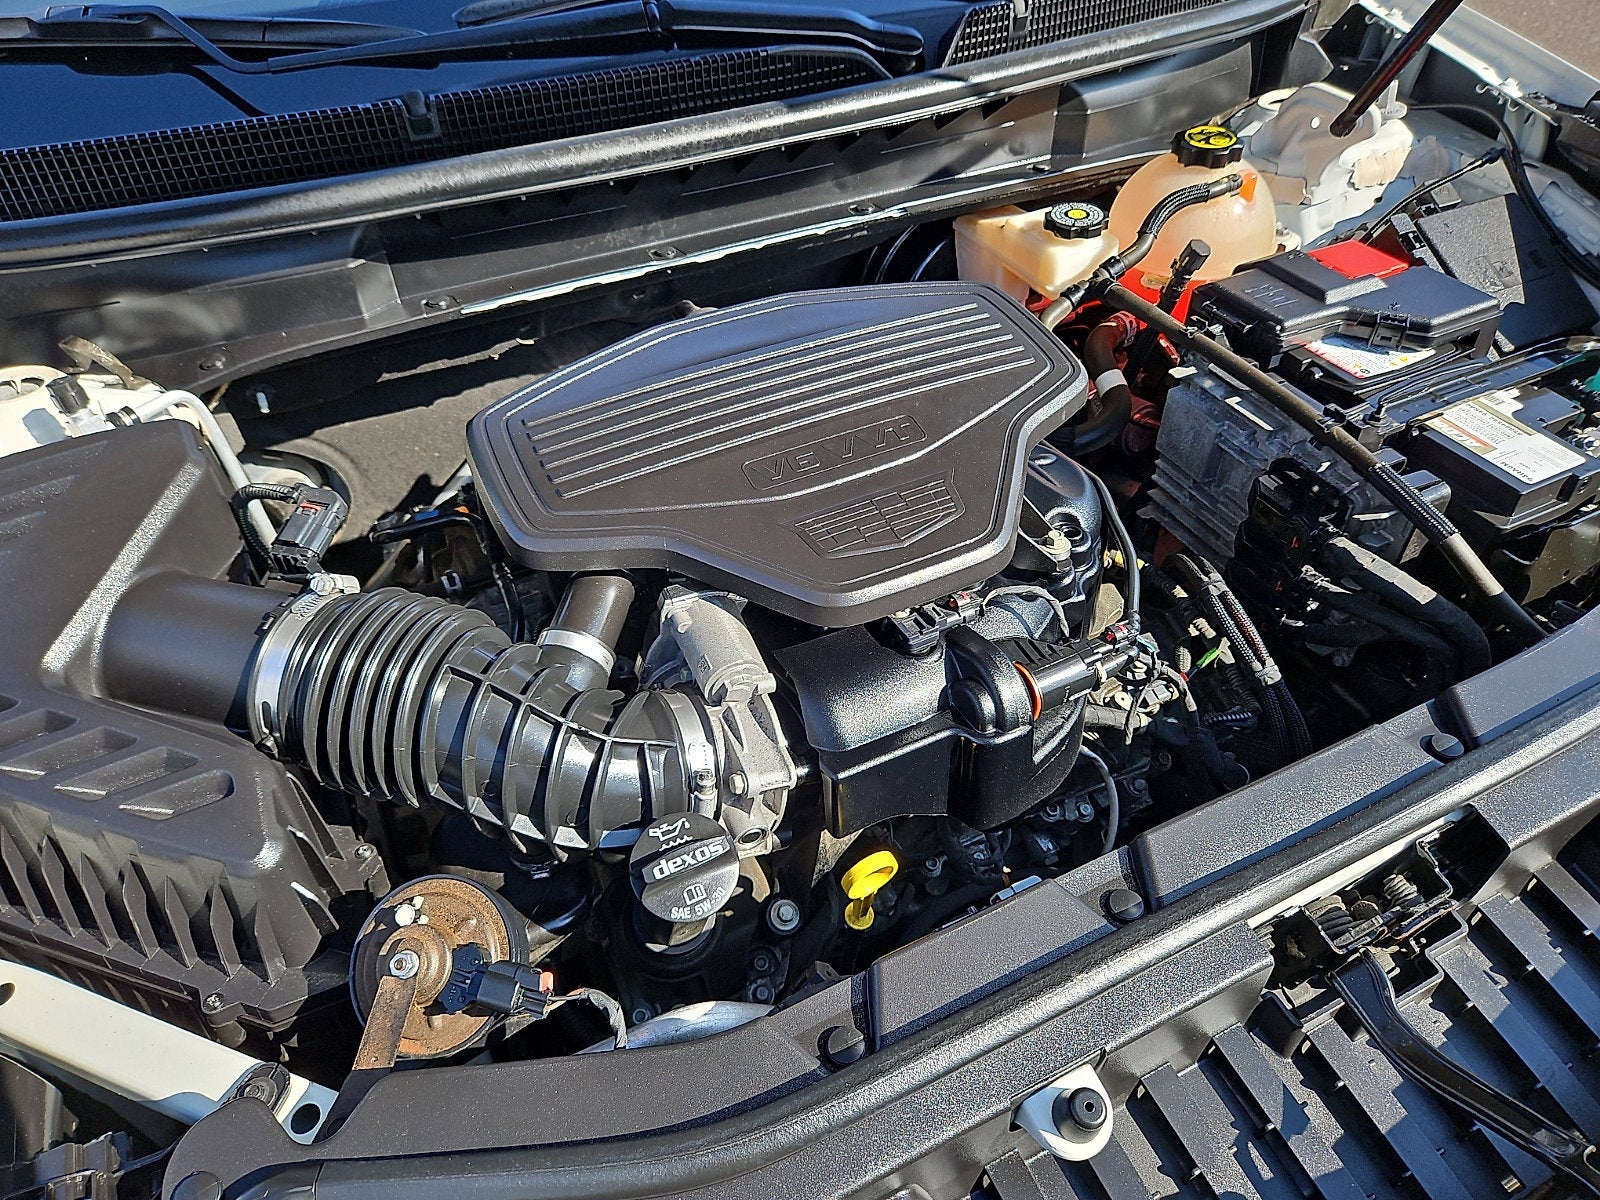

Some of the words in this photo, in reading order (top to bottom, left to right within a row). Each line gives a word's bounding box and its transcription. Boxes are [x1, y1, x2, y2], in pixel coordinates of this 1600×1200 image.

[752, 451, 821, 480] V6
[821, 422, 911, 458] VVT
[652, 840, 725, 880] dexos
[670, 906, 692, 920] SAE
[694, 886, 726, 916] 5W-30
